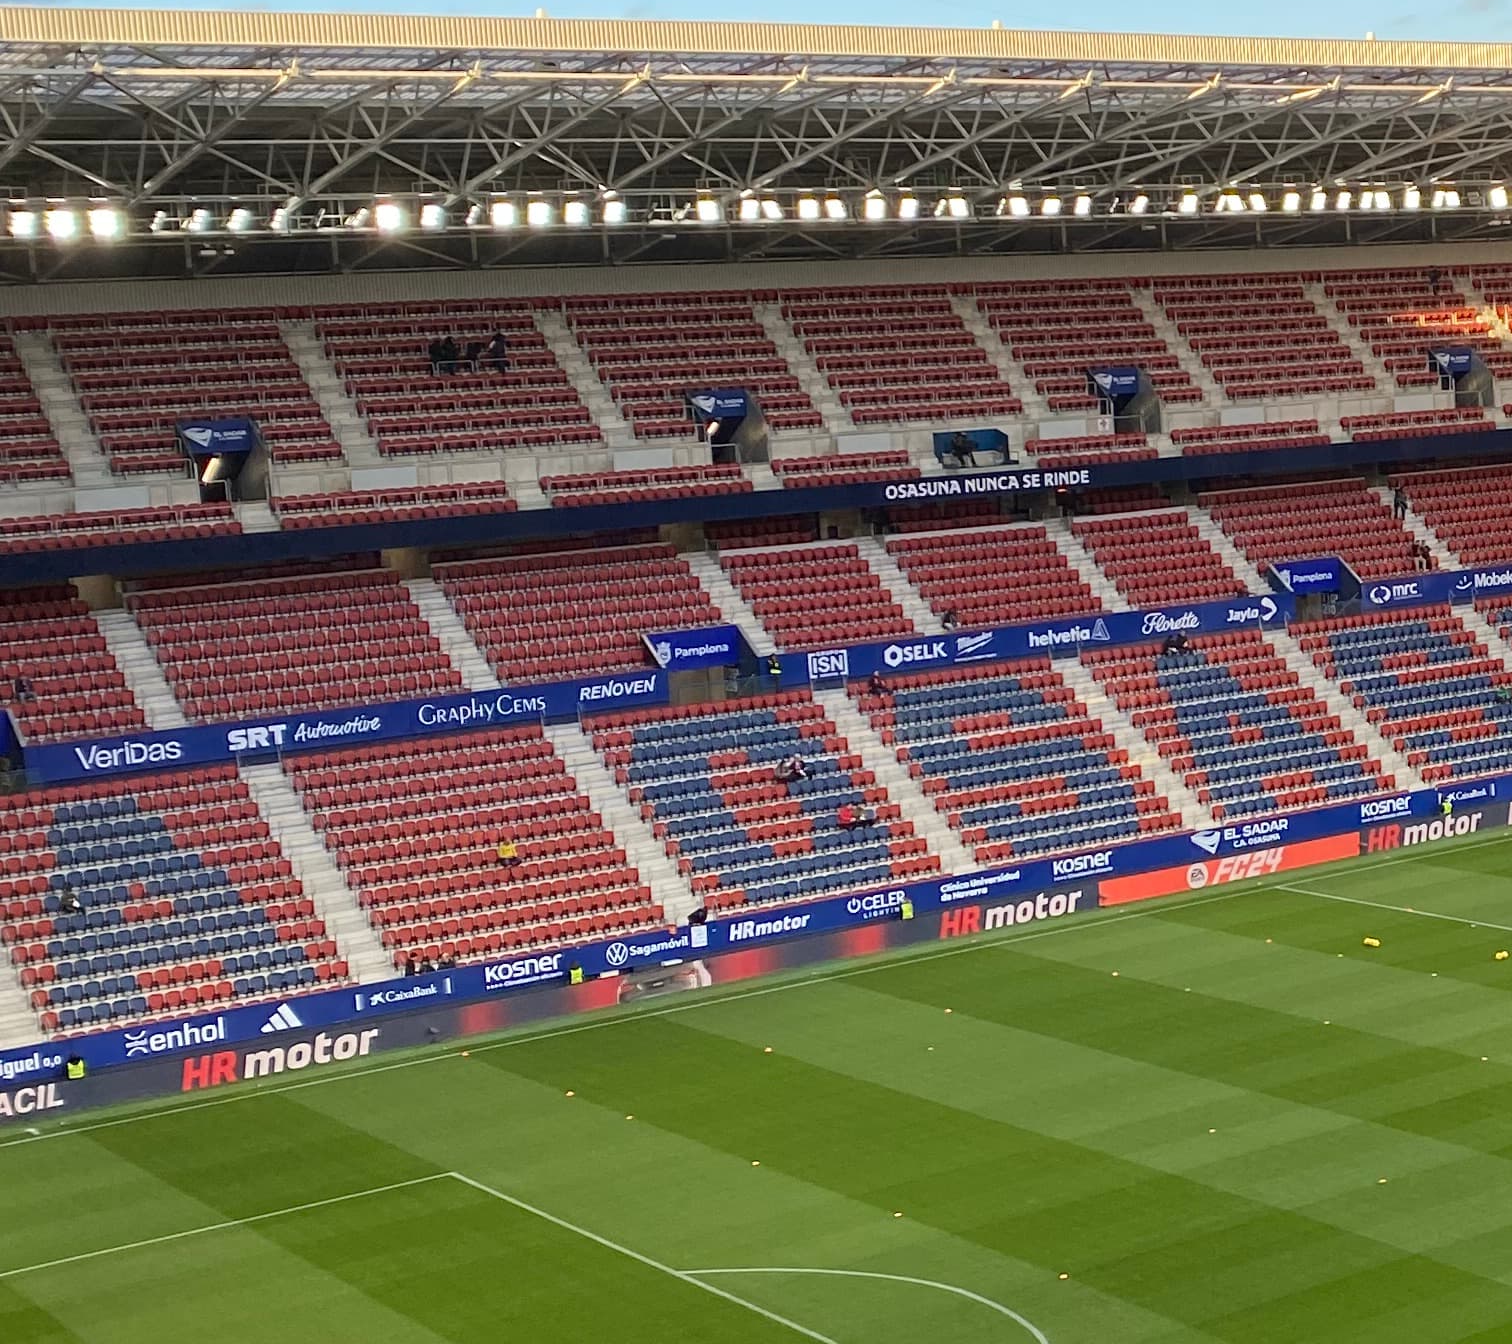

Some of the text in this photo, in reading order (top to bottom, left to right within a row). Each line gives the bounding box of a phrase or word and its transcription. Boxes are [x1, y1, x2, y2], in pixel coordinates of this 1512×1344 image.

[885, 470, 1090, 500] OSASUNA NUNCA SE RINDE
[1392, 581, 1418, 596] mrc
[1142, 611, 1200, 634] Florette
[1028, 625, 1090, 648] helvetia
[675, 642, 729, 658] Pamplona
[228, 724, 288, 751] SRT
[294, 715, 380, 742] Automotive
[1224, 819, 1289, 841] EL SADAR
[862, 891, 905, 911] CELER
[629, 936, 689, 957] Sagamóvil
[385, 984, 438, 1003] CaixaBank
[150, 1017, 226, 1054] enhol
